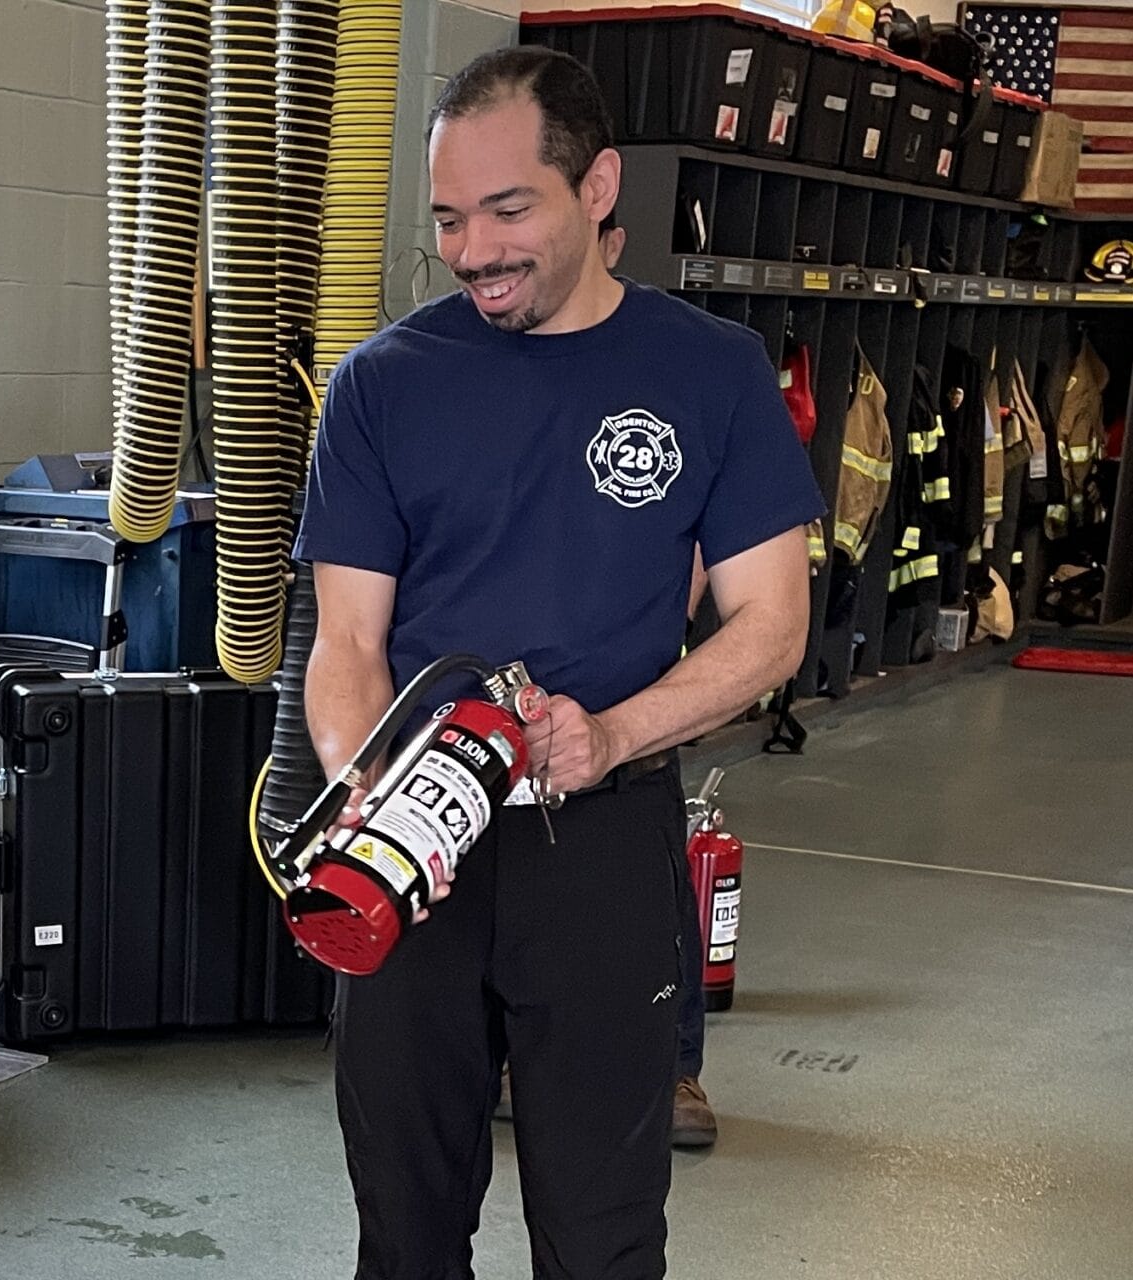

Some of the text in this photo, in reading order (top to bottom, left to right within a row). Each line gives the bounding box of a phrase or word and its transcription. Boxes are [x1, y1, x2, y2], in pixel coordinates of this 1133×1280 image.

[614, 417, 662, 434] ODENTON
[617, 444, 654, 470] 28
[454, 735, 490, 766] LION
